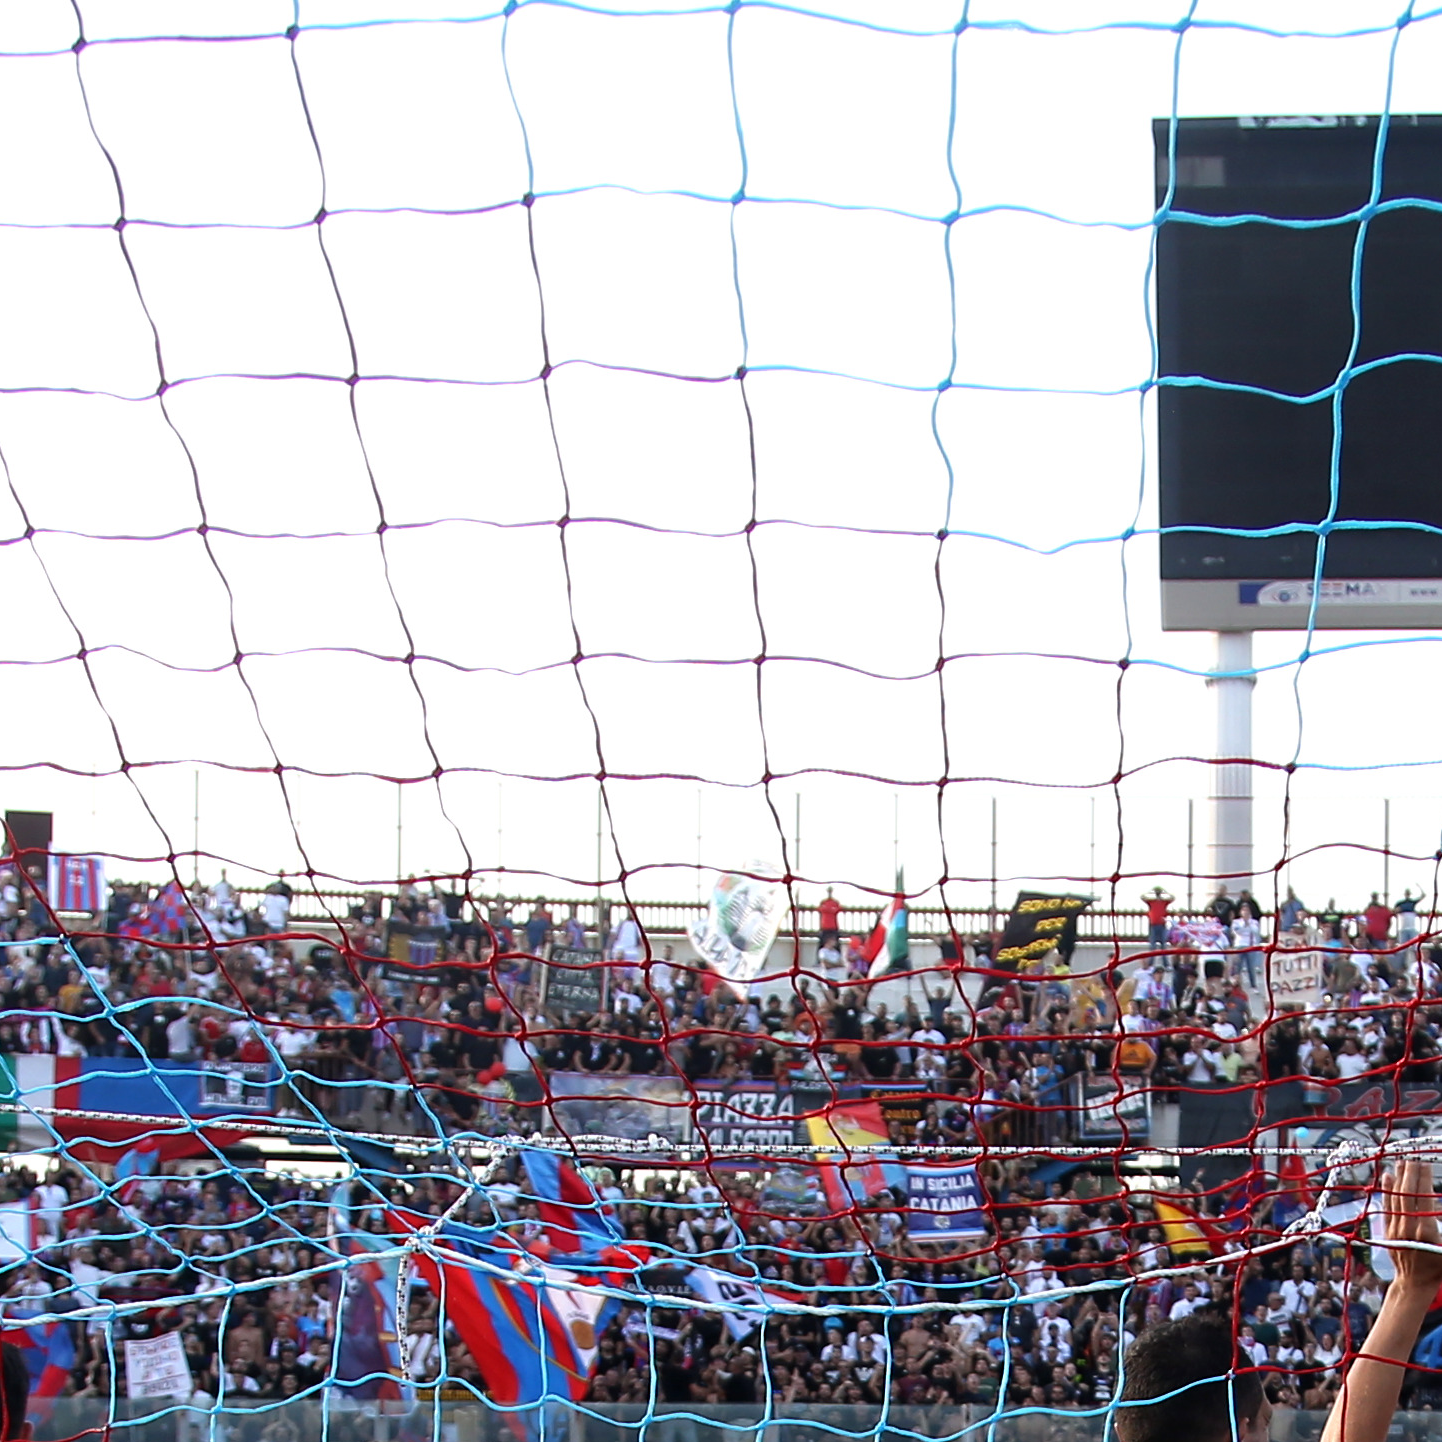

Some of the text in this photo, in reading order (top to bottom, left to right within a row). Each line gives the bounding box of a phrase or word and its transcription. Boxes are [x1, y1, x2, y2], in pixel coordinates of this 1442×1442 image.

[696, 1090, 795, 1125] PIAZZA
[927, 1174, 976, 1191] SICILIA
[909, 1194, 979, 1213] CATANIA
